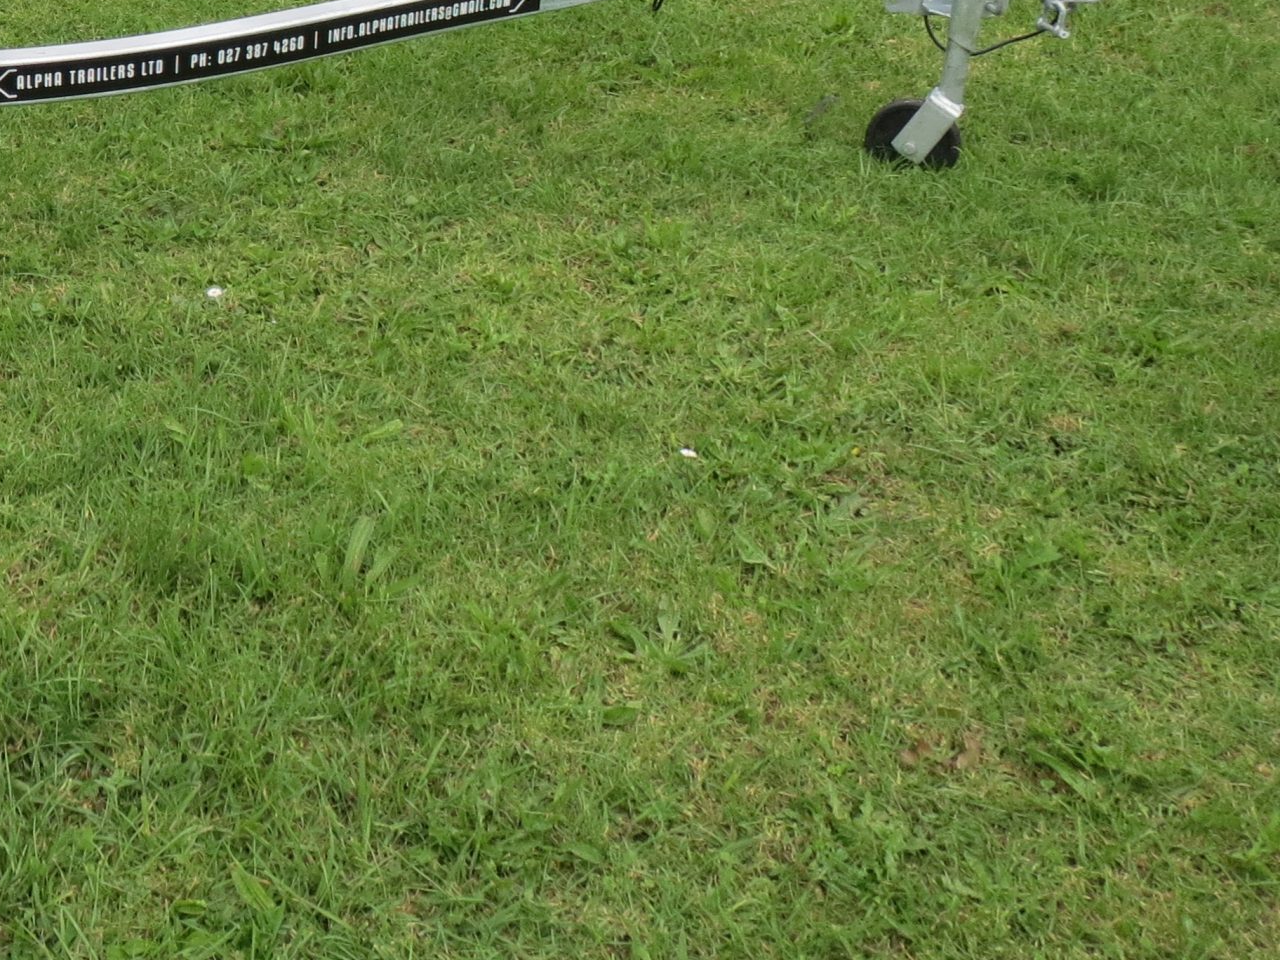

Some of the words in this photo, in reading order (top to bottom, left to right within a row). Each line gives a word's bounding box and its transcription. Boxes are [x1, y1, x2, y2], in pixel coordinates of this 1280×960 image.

[16, 71, 63, 90] ALPHA
[70, 63, 135, 85] TRAILERS
[141, 59, 164, 76] LTD
[190, 53, 212, 69] PH:
[217, 47, 241, 64] 027
[246, 42, 268, 59] 387
[273, 35, 305, 54] 4260
